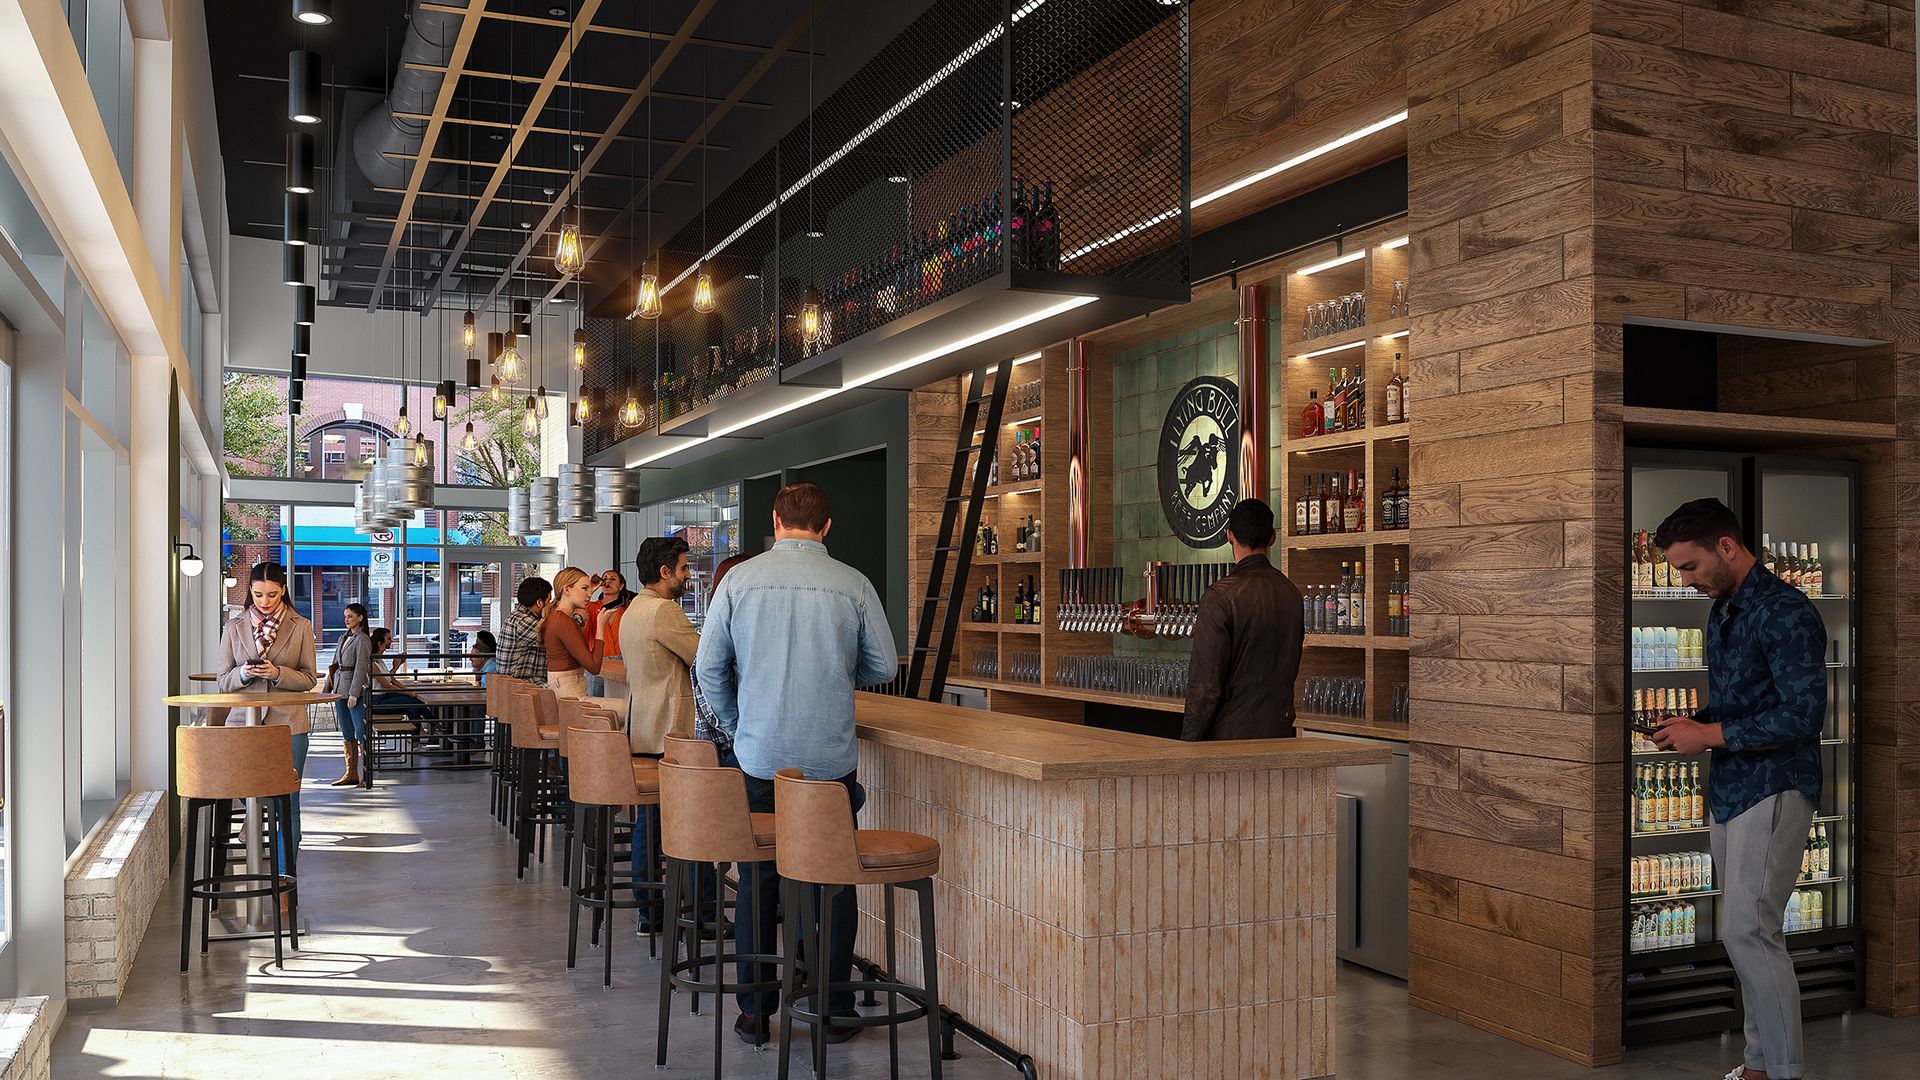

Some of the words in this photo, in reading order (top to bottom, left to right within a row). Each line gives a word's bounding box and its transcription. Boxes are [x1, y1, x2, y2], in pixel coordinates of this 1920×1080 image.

[1170, 389, 1203, 448] LYING
[1207, 389, 1237, 439] BULL
[1194, 484, 1236, 533] COMPANY
